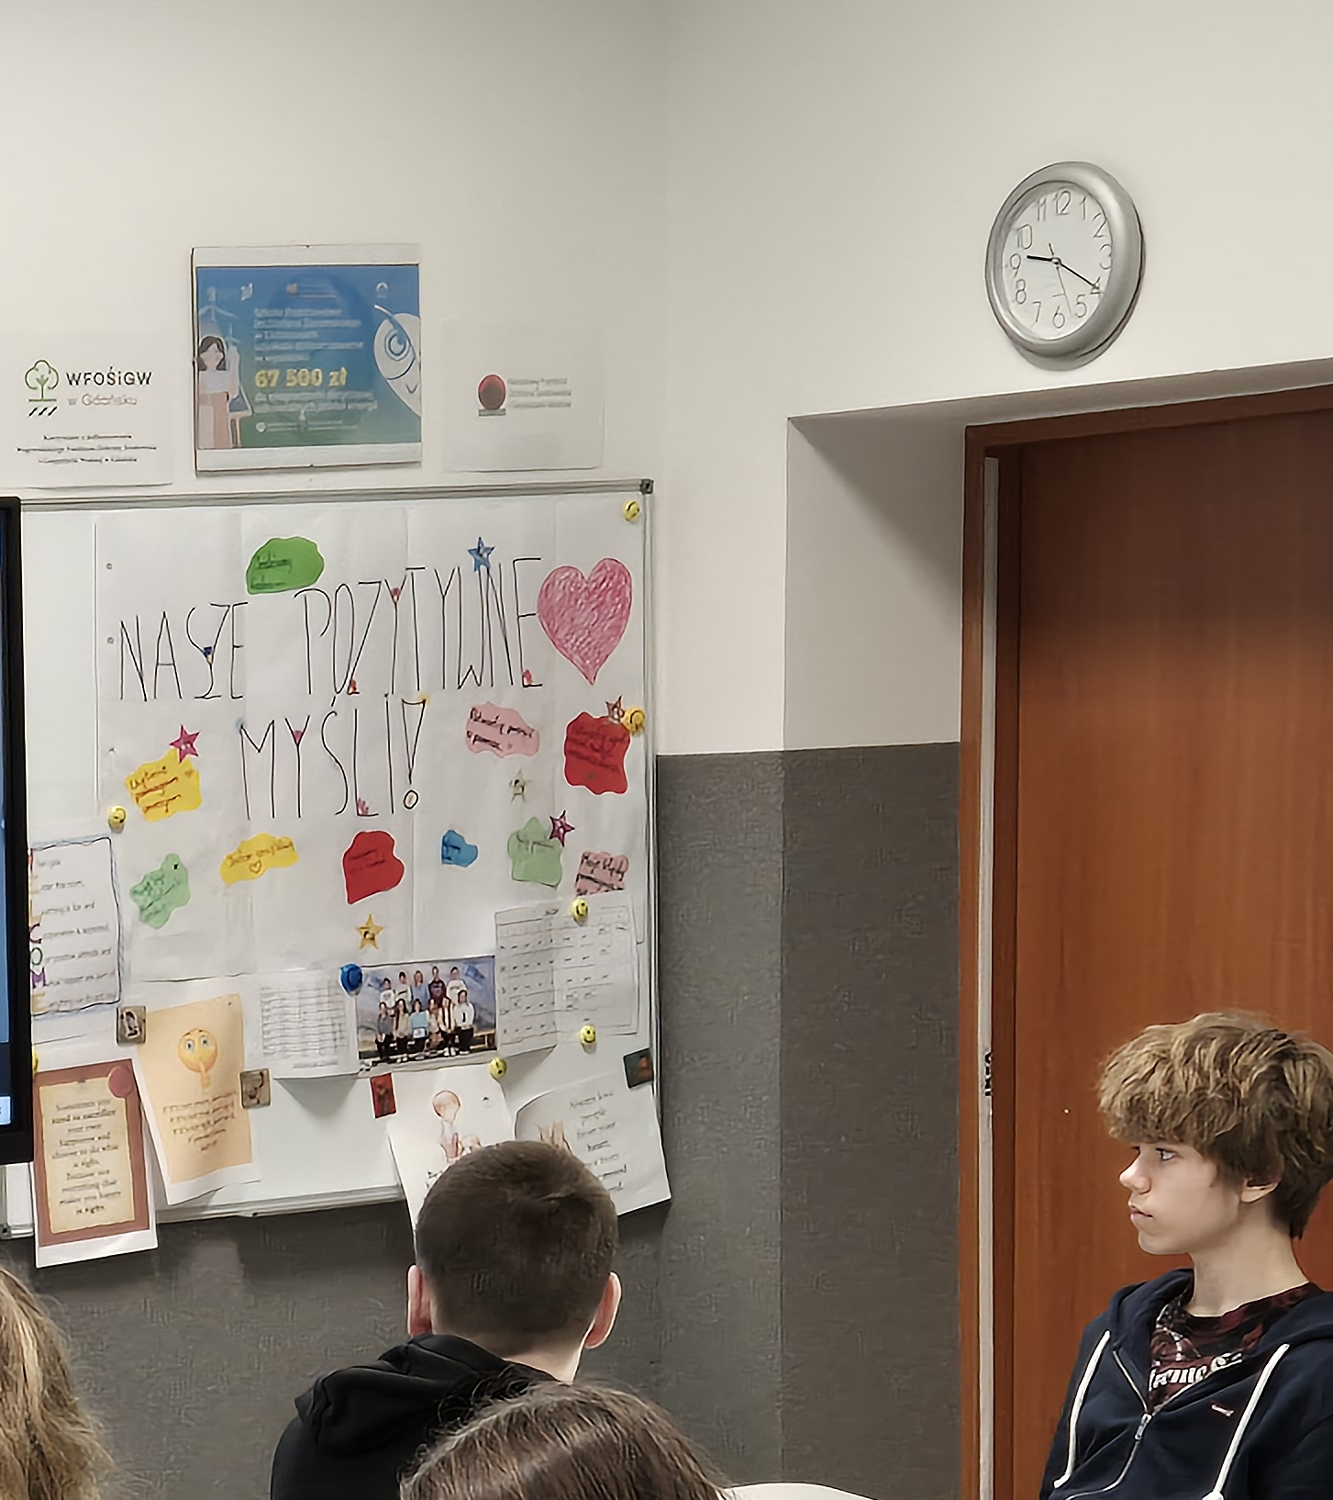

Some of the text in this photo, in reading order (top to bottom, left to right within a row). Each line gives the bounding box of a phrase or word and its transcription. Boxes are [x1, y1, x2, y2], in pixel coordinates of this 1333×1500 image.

[1036, 197, 1048, 222] 11
[1054, 190, 1072, 216] 12
[1079, 196, 1087, 220] 1
[1016, 223, 1033, 250] 10
[1092, 212, 1108, 238] 2
[1009, 252, 1022, 278] 9
[1099, 243, 1113, 270] 3
[1015, 278, 1027, 305] 8
[1031, 301, 1042, 323] 7
[1052, 305, 1066, 329] 6
[1074, 293, 1088, 318] 5
[254, 368, 280, 388] 67
[294, 558, 543, 696] POZYTYWNE
